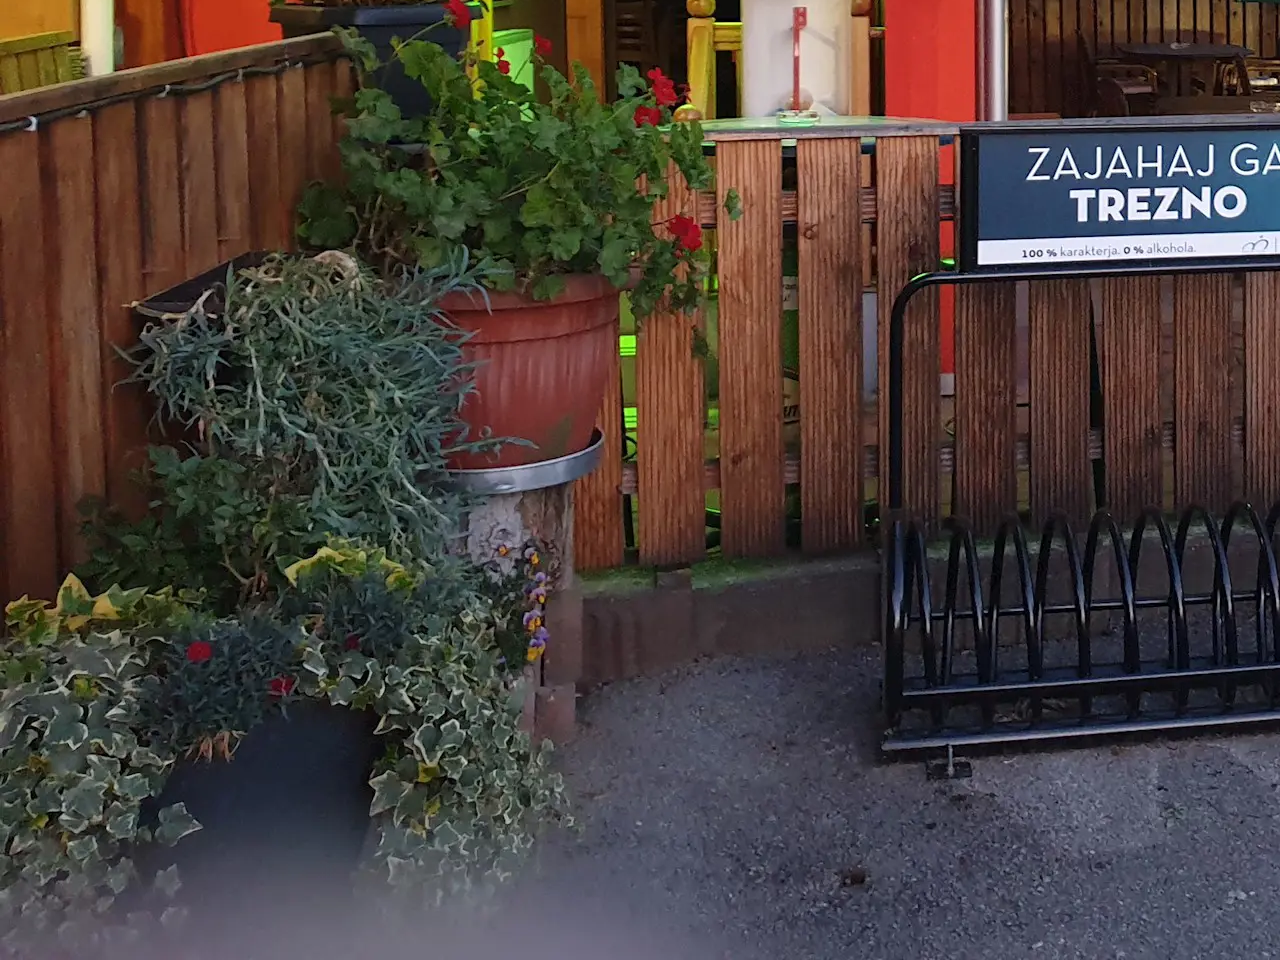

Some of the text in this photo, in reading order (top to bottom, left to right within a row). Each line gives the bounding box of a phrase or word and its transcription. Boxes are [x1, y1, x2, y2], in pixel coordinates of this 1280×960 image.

[1026, 143, 1215, 181] ZAJAHAJ
[1069, 184, 1248, 223] TREZNO
[1022, 241, 1197, 258] 100 % karakterja. 0 % alkohola.
